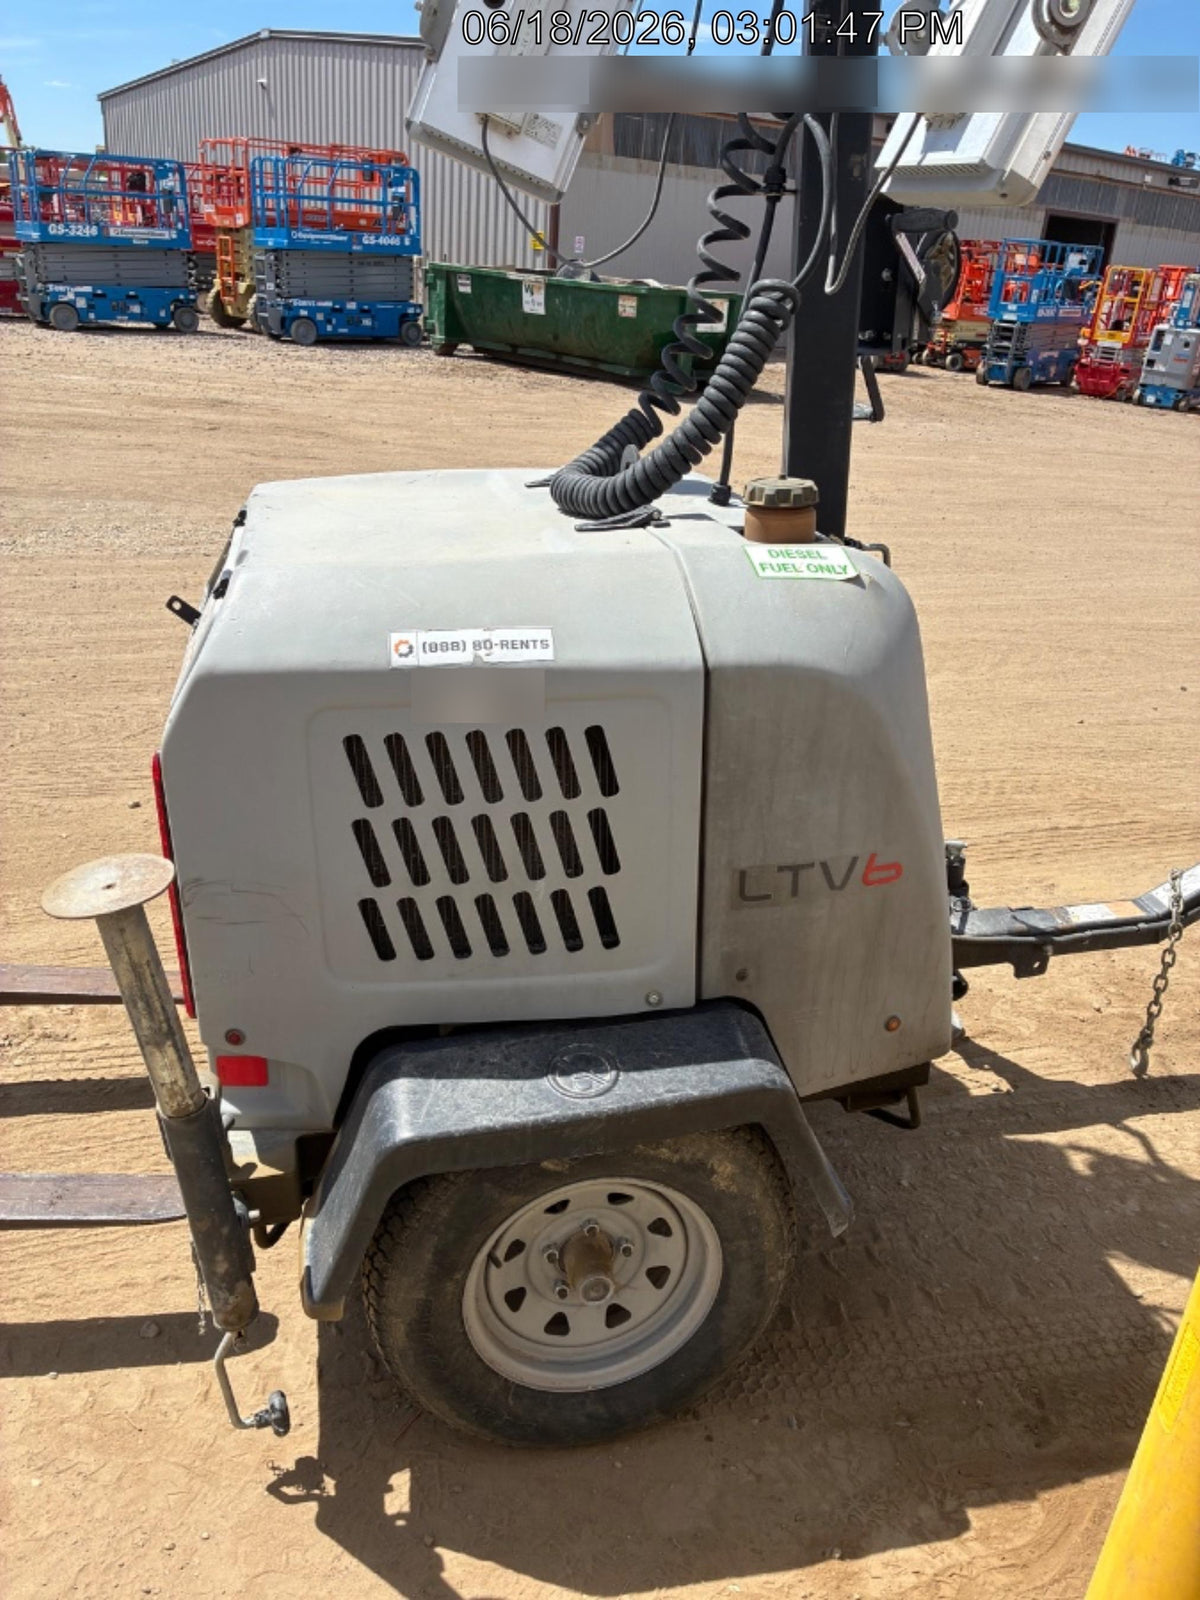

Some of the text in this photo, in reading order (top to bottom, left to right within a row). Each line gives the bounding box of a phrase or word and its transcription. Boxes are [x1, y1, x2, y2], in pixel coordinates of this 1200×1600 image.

[768, 549, 828, 559] DIESEL
[759, 562, 848, 575] FUEL ONLY
[739, 852, 904, 902] LTV6
